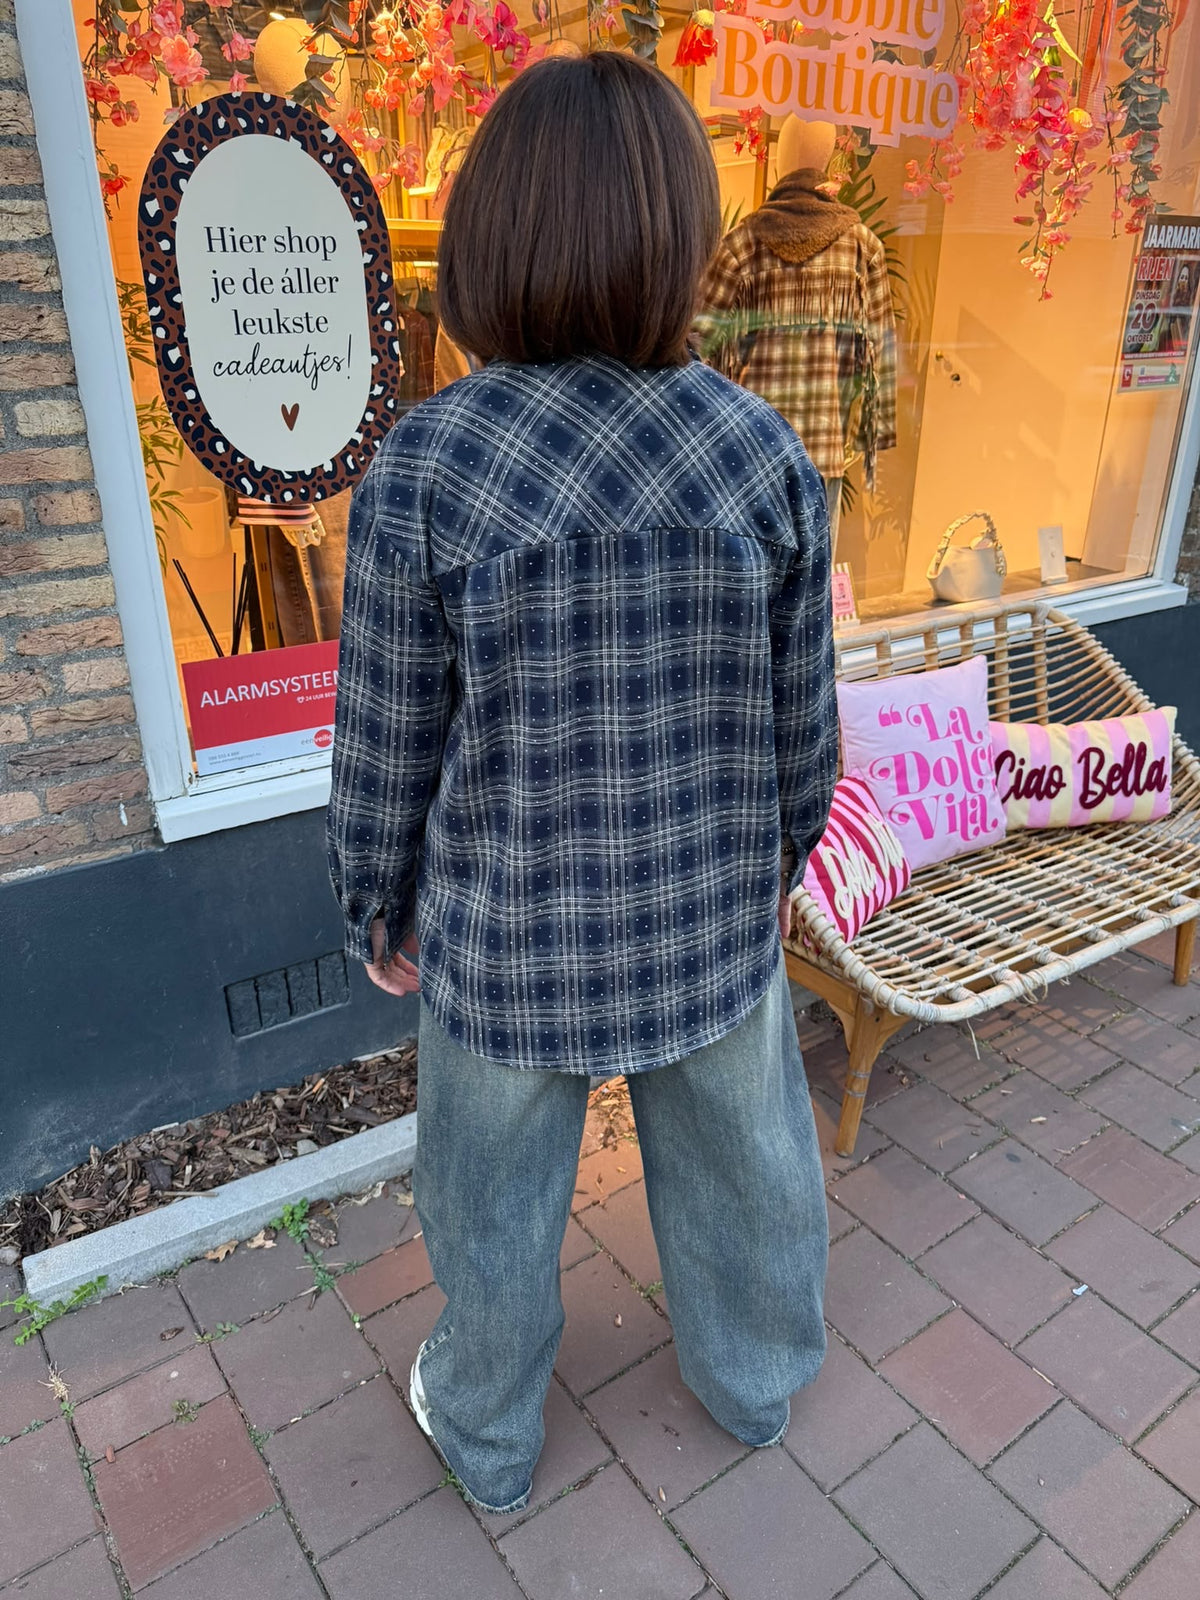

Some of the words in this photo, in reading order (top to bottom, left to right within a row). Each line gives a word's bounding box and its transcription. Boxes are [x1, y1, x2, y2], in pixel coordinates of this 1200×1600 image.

[719, 26, 954, 136] Boutique
[203, 226, 267, 253] Hier
[273, 226, 338, 261] shop
[211, 269, 236, 303] je
[242, 267, 275, 295] de
[281, 267, 339, 294] áller
[1137, 256, 1175, 281] RIJEN
[231, 308, 329, 335] leukste
[1130, 302, 1157, 330] 20
[1126, 333, 1154, 344] OKTOBER
[212, 334, 352, 391] cadeautjes!
[994, 749, 1067, 805] Ciao
[1076, 741, 1168, 810] Bella
[887, 791, 999, 842] Vita
